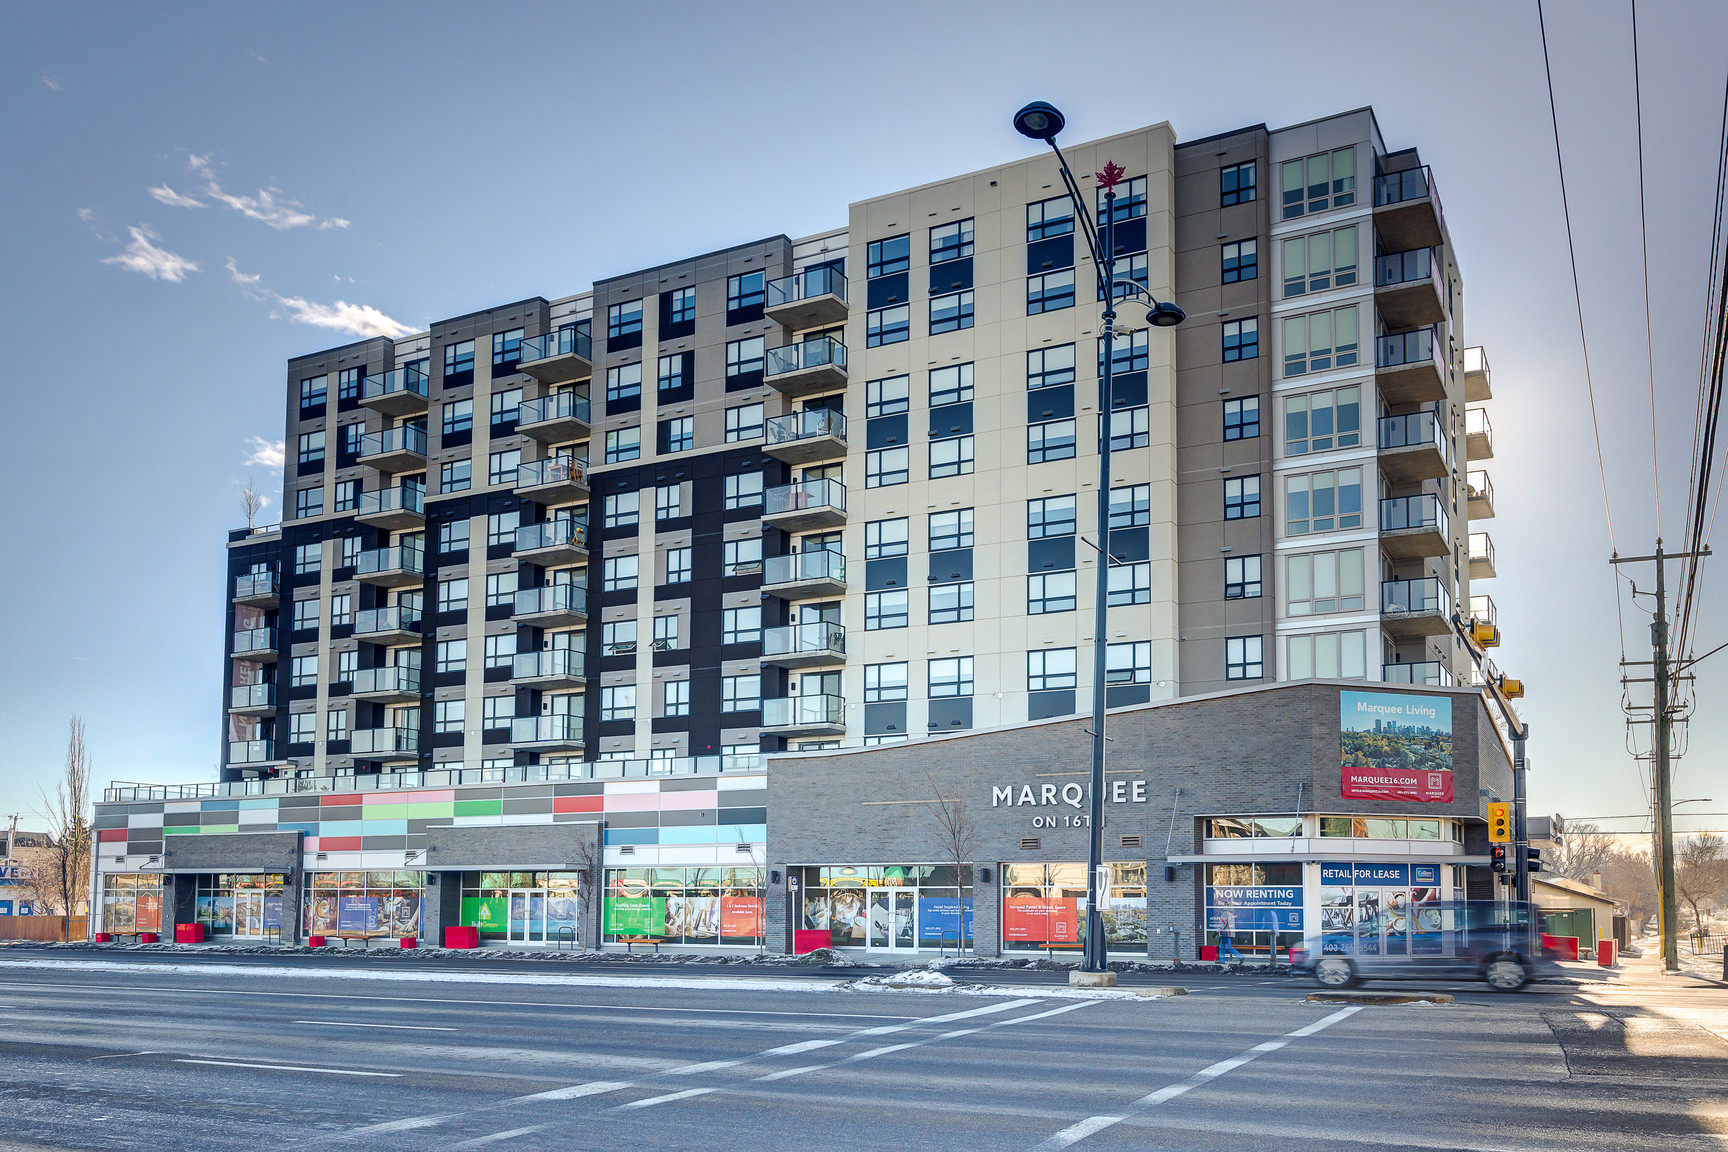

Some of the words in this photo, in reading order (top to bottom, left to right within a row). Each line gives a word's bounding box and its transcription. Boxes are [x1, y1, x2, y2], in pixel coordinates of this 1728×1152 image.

[1357, 702, 1402, 716] Marquee
[1406, 704, 1436, 718] Living
[1350, 776, 1418, 785] MARQUEE16.COM
[1032, 816, 1057, 828] ON
[1064, 815, 1106, 828] 16T
[1322, 869, 1352, 878] RETAIL
[1354, 870, 1371, 878] FOR
[1373, 870, 1400, 878] LEASE
[1216, 889, 1244, 898] NOW
[1246, 889, 1294, 898] RENTING
[1323, 944, 1338, 952] 403
[1340, 944, 1354, 952] 266
